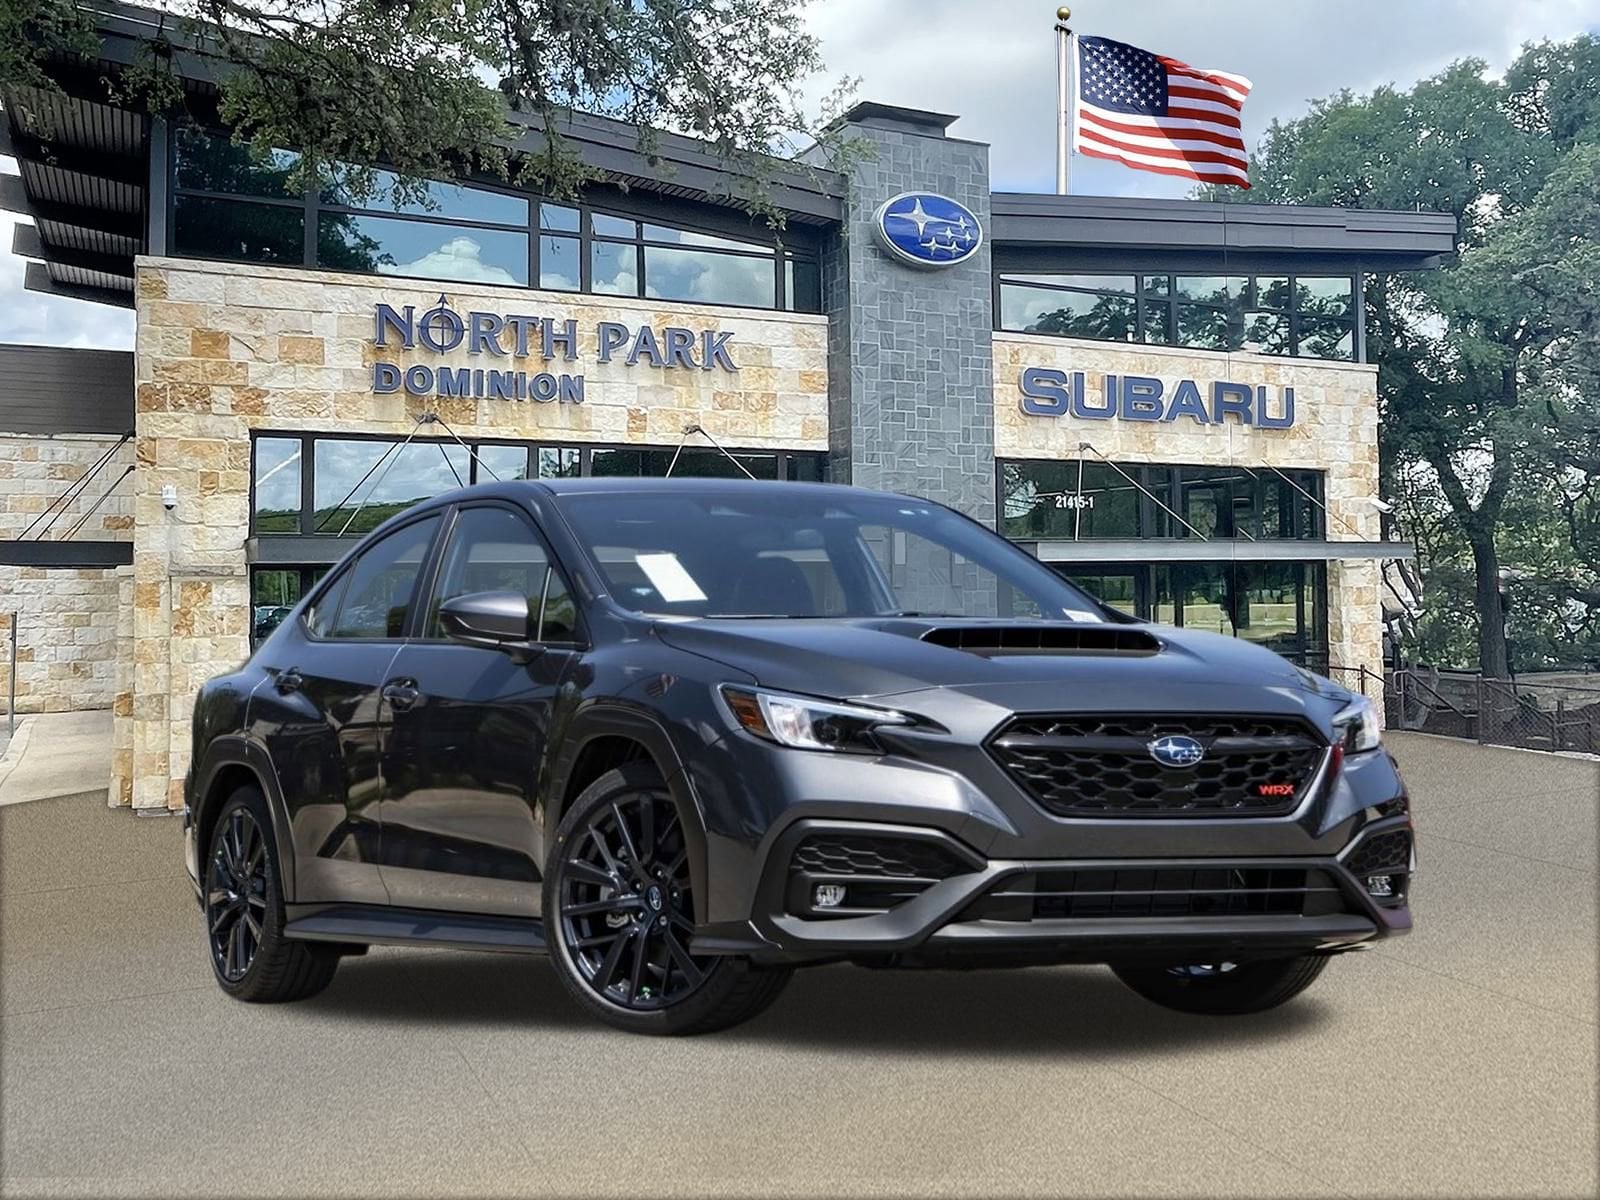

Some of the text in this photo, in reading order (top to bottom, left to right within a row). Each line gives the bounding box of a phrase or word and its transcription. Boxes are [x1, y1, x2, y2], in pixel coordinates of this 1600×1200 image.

[374, 292, 740, 373] NORTH PARK
[373, 362, 585, 404] DOMINION
[1019, 366, 1295, 430] SUBARU
[1259, 784, 1294, 796] WRX
